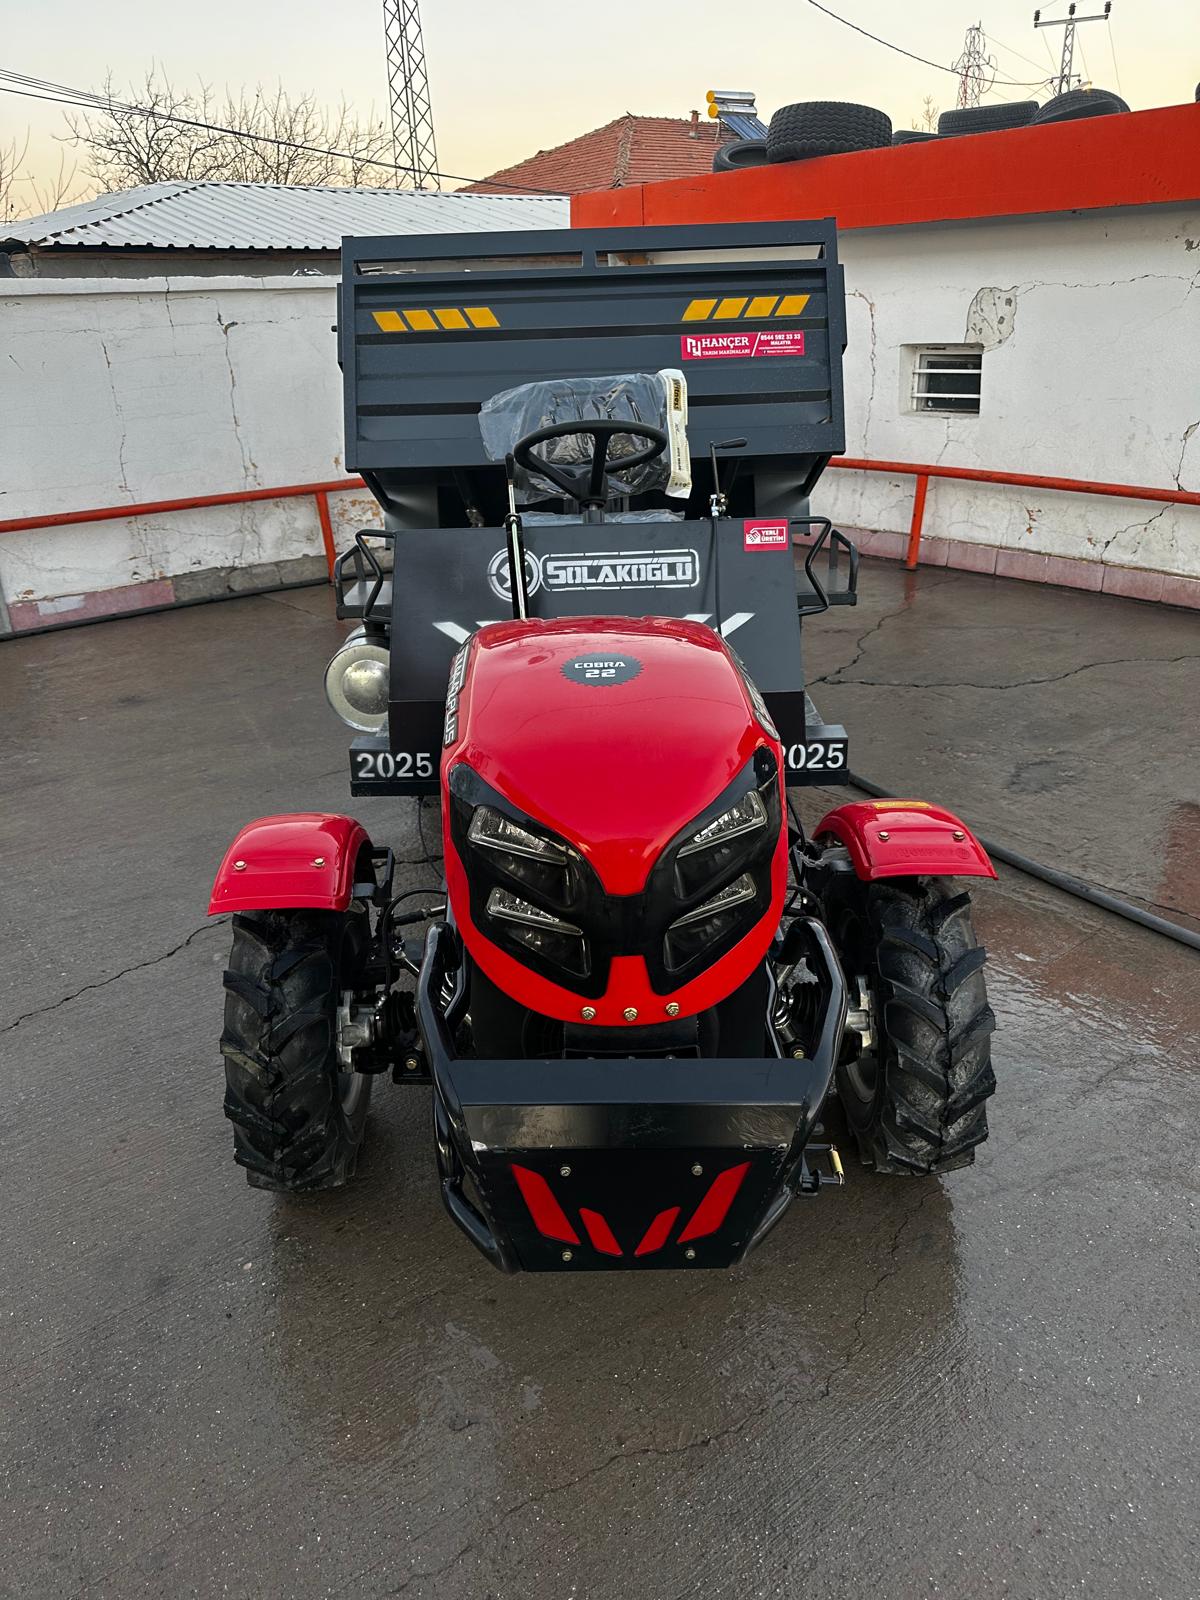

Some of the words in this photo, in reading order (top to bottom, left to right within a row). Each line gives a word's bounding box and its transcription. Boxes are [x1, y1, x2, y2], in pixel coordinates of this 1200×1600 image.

[701, 337, 749, 349] HANÇER
[574, 661, 626, 669] COBRA
[585, 668, 616, 678] 22
[356, 752, 433, 778] 2025
